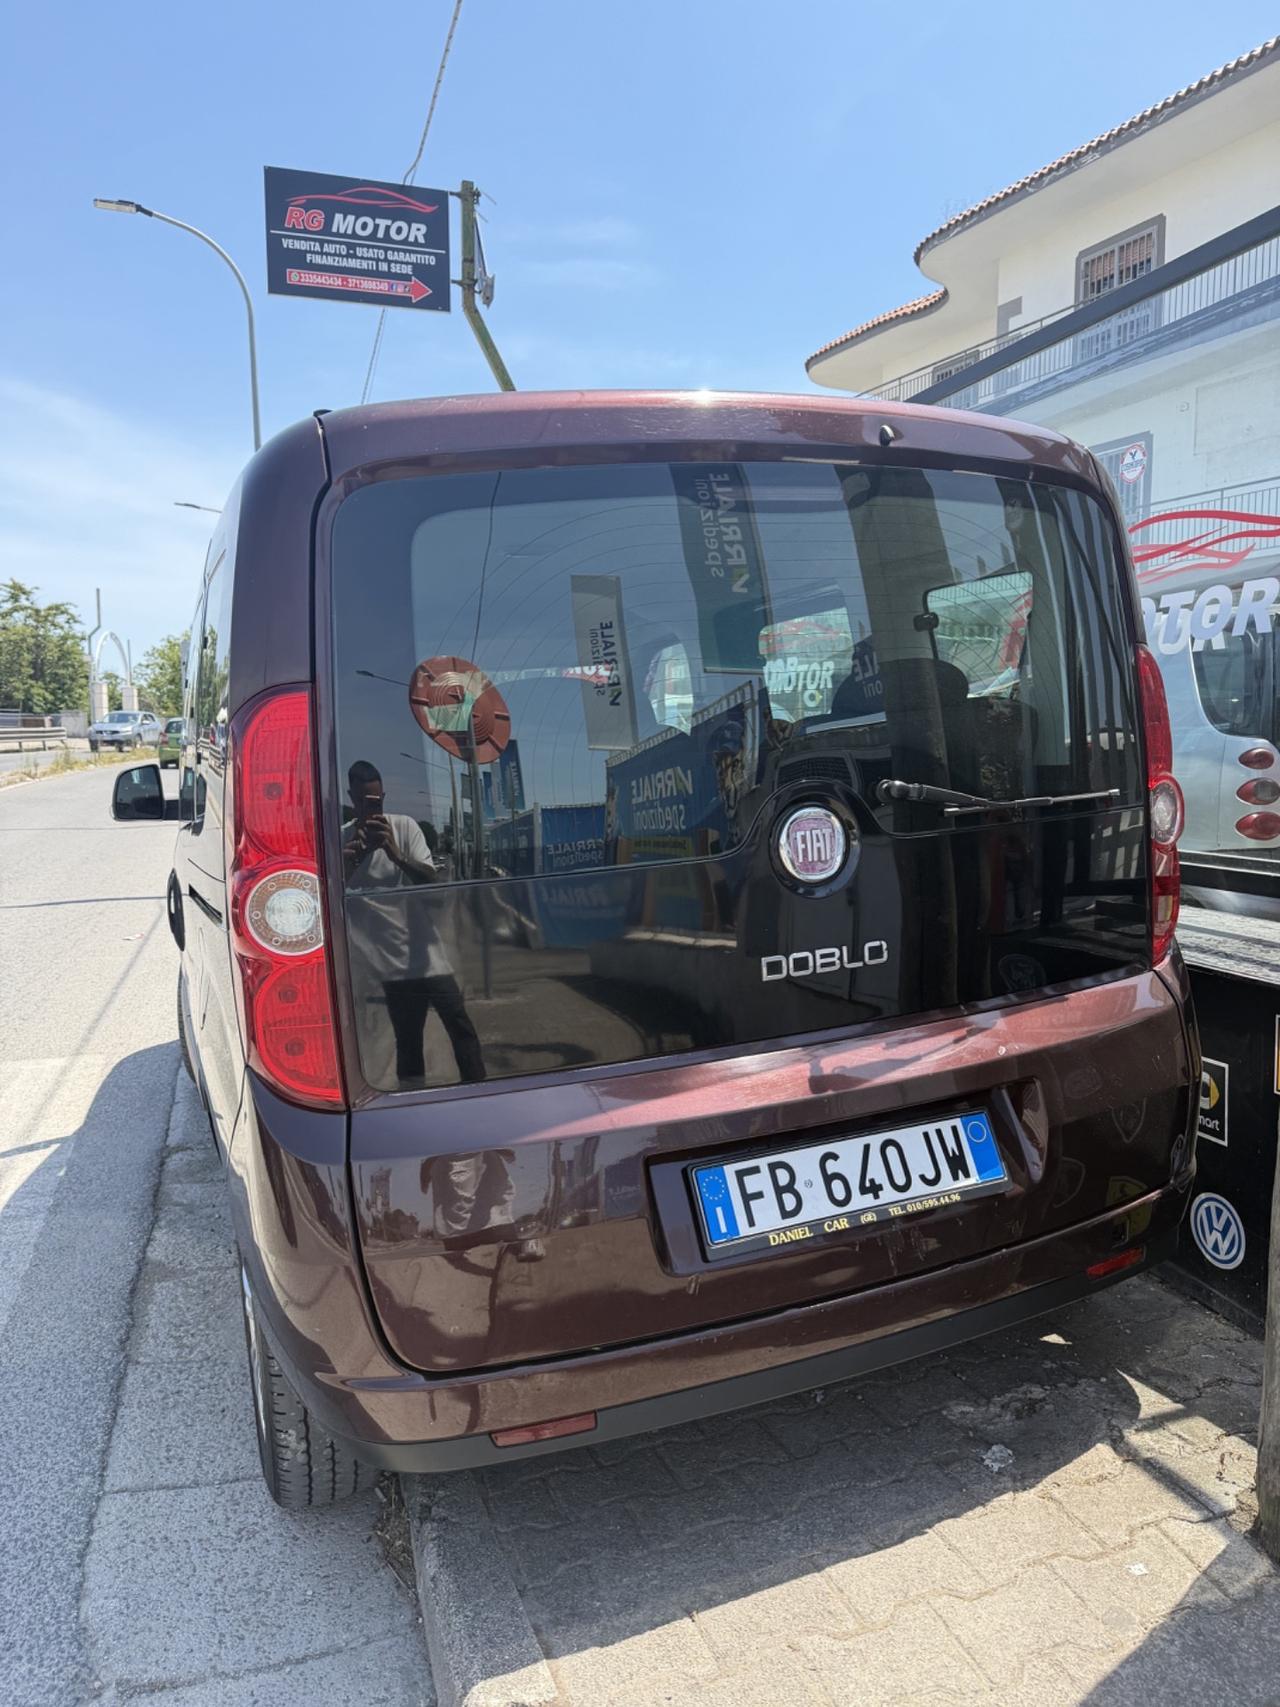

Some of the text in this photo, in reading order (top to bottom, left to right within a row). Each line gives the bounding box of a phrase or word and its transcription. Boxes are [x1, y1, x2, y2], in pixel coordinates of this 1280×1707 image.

[284, 206, 428, 244] RG MOTOR
[281, 238, 321, 253] VENDITA
[323, 243, 347, 256] AUTO
[356, 247, 385, 260] USATO
[387, 251, 436, 266] GARANTITO
[306, 254, 413, 275] FINANZIAMENTI IN SEDE
[796, 828, 834, 863] FIAT
[761, 940, 888, 982] DOBLO
[1199, 1113, 1220, 1132] mart
[734, 1160, 803, 1228] FB
[768, 1225, 814, 1246] DANIEL
[823, 1217, 849, 1234] CAR
[860, 1212, 877, 1225] (GE)
[888, 1203, 906, 1217] TEL.
